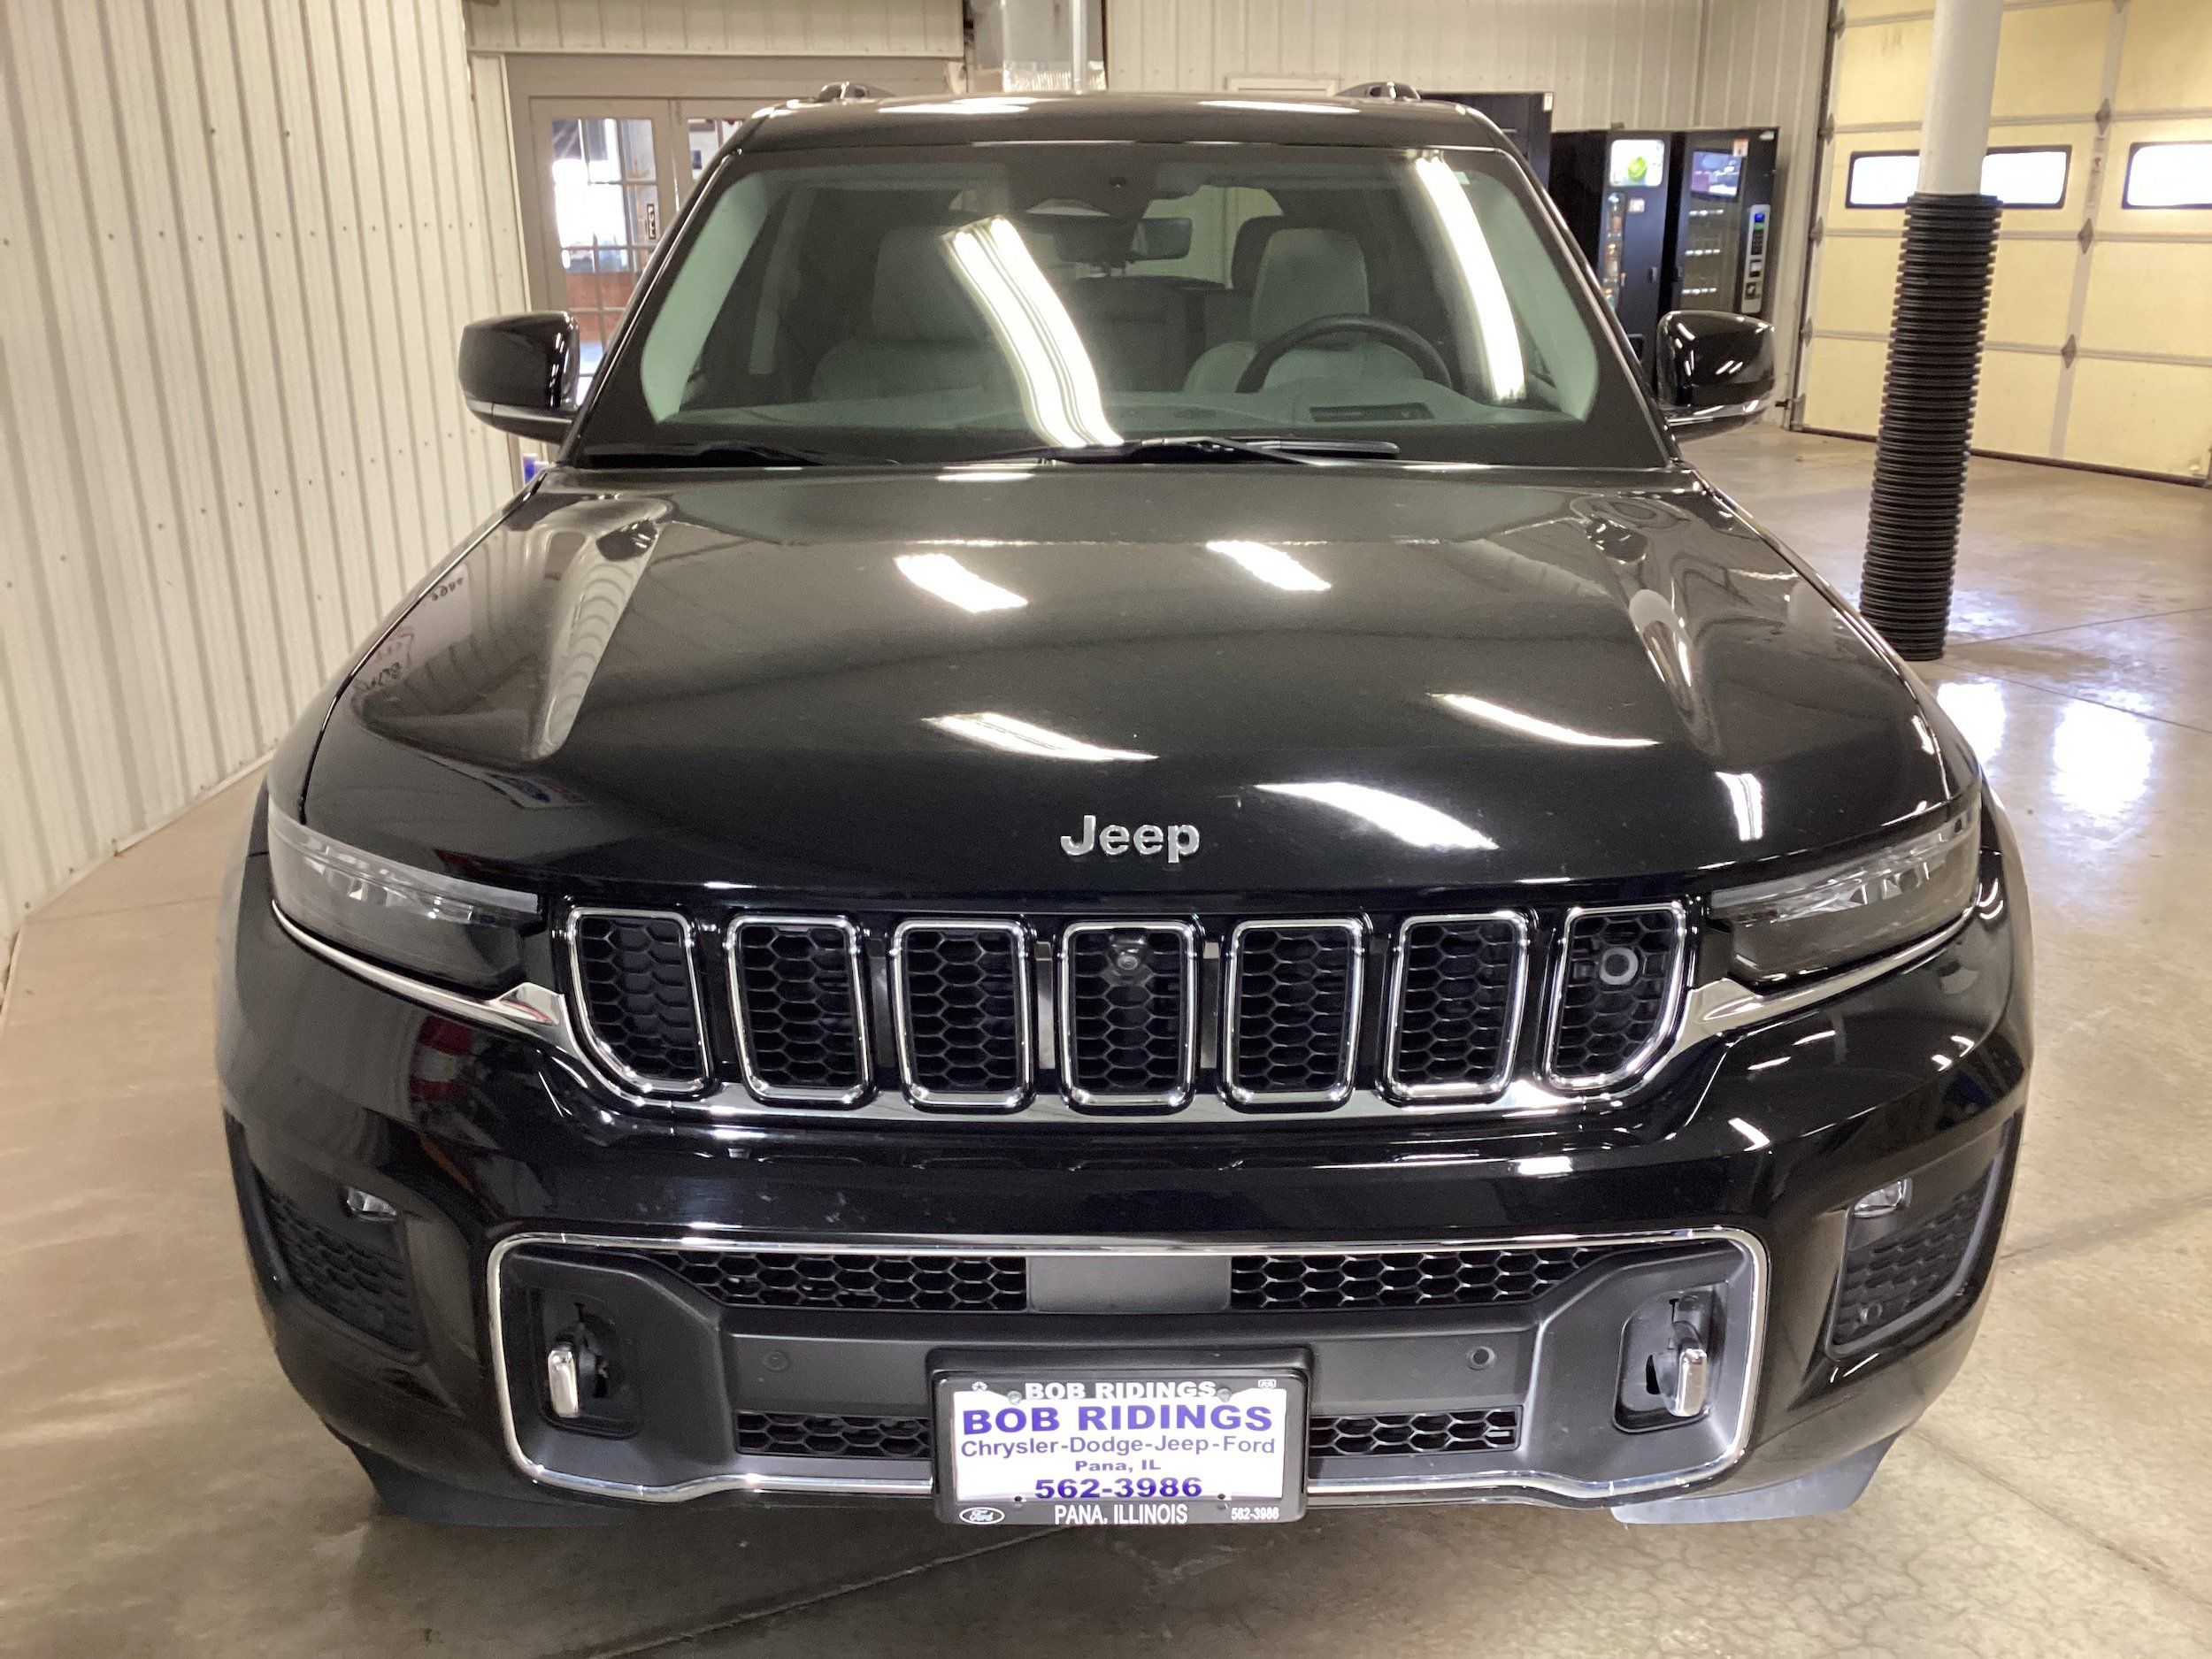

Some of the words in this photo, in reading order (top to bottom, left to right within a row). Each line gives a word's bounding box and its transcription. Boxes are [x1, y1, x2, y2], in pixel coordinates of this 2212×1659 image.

[1060, 814, 1200, 864] Jeep
[1025, 1381, 1086, 1400] BOB
[1095, 1380, 1217, 1399] RIDINGS
[963, 1407, 1061, 1435] BOB
[1078, 1404, 1272, 1432] RIDINGS
[1075, 1460, 1133, 1473] Pana,
[1141, 1459, 1161, 1471] IL
[1034, 1477, 1202, 1499] 562-3986
[969, 1507, 994, 1522] Ford
[1054, 1504, 1109, 1525] PANA,
[1113, 1503, 1188, 1525] ILLINOIS
[1231, 1506, 1279, 1521] 562-3986
